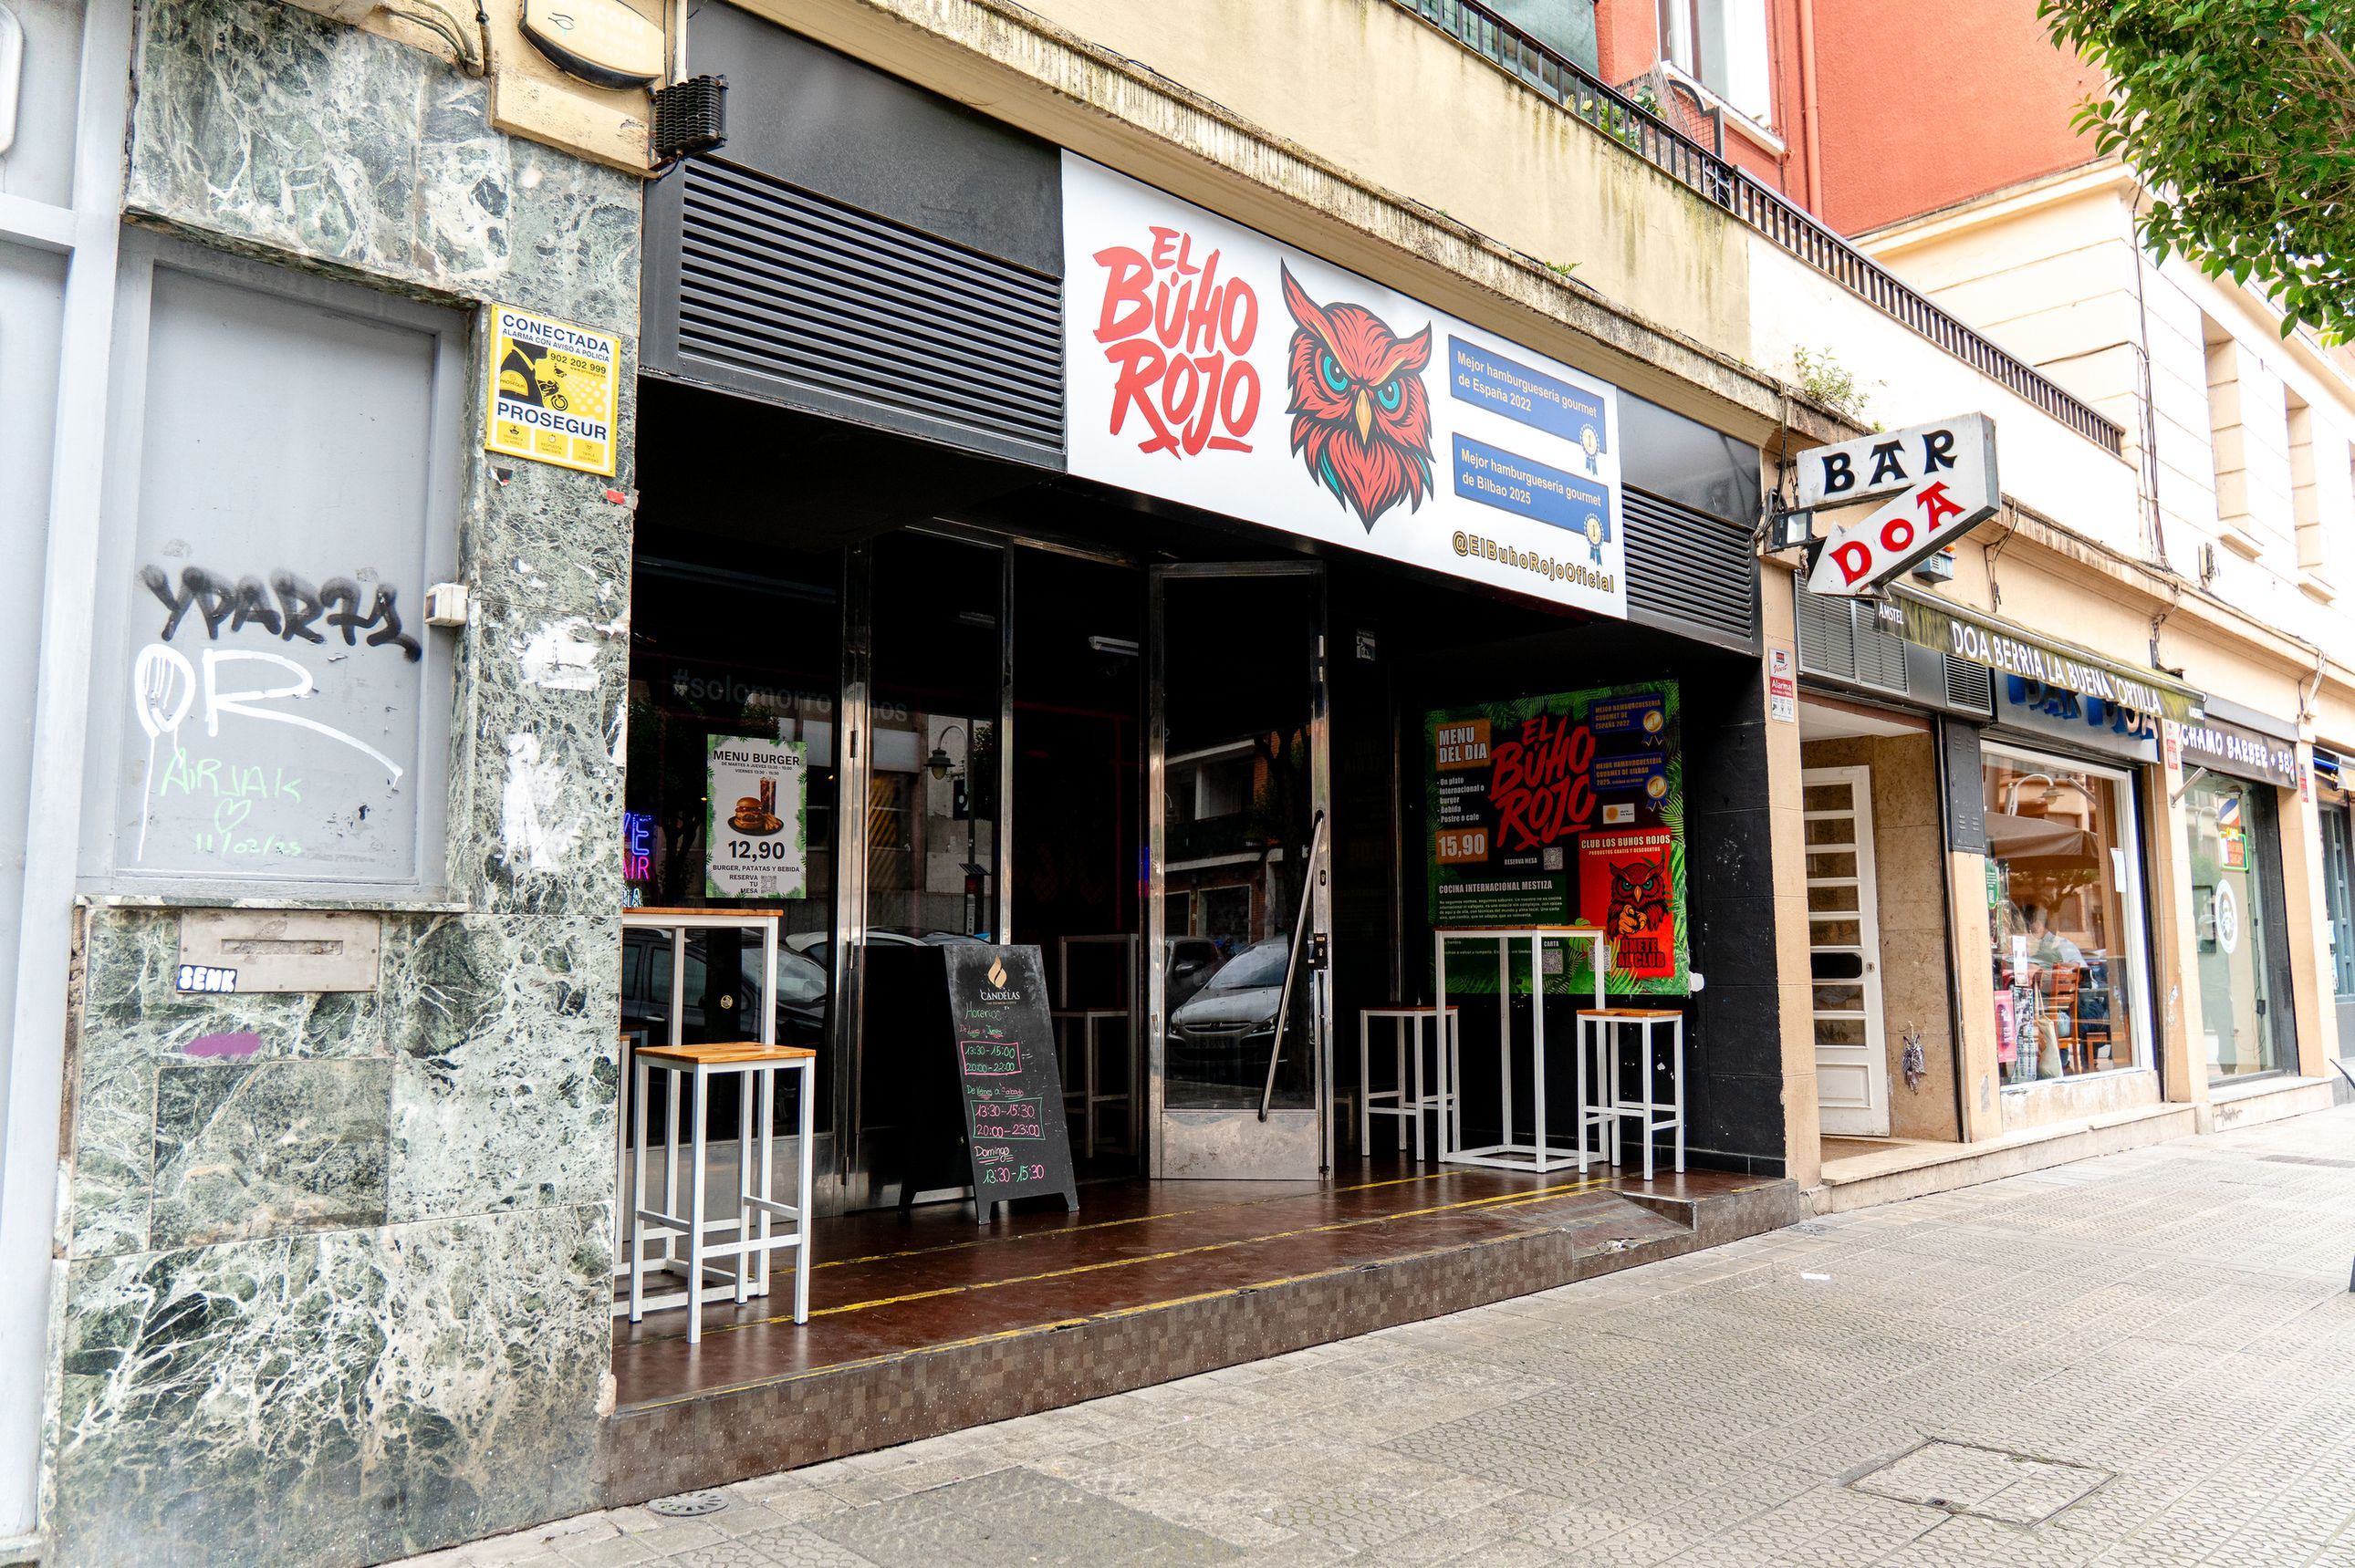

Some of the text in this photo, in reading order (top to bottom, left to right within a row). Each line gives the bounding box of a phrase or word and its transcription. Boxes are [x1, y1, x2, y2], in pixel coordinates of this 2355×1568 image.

[1149, 226, 1202, 275] EL
[503, 315, 610, 354] CONECTADA
[503, 328, 534, 342] ALARMA
[536, 337, 552, 347] CON
[553, 341, 574, 353] AVISO
[550, 352, 607, 375] 902 202 999
[1457, 350, 1598, 419] Mejor hamburguesería gourmet
[1458, 373, 1532, 411] de España 2022
[1104, 338, 1262, 461] ROJO
[497, 401, 607, 440] PROSEGUR
[1821, 429, 1958, 495] BAR
[1461, 448, 1601, 507] Mejor hamburguesería gourmet
[1462, 472, 1531, 504] de Bilbao 2025
[1829, 481, 1966, 587] DOA
[1453, 530, 1615, 593] @ElBuhoRojoOficial
[1879, 601, 1904, 625] AMSTEL
[1952, 620, 1993, 663] DOA
[1993, 635, 2046, 680] BERRIA
[2046, 653, 2068, 686] LA
[2066, 660, 2115, 699] BUENA
[1438, 726, 1474, 746] MENU
[1521, 716, 1557, 746] EL
[714, 750, 800, 766] MENU BURGER
[1439, 742, 1488, 763] DEL DIA
[2181, 724, 2224, 756] CHAMO
[2226, 735, 2267, 768] BARBER
[1440, 815, 1460, 824] Postre
[1493, 774, 1597, 853] ROJO
[728, 840, 786, 863] 12,90
[1438, 833, 1485, 857] 15,90
[1581, 835, 1671, 849] CLUB LOS BUHOS ROJOS
[713, 864, 741, 872] BURGER,
[1438, 879, 1553, 895] COCINA INTERNACIONAL MESTIZA
[1617, 951, 1666, 968] AL CLUB
[980, 988, 1020, 1001] CANDELAS
[964, 1001, 1002, 1021] Horarios
[966, 1085, 975, 1095] De
[974, 1145, 1010, 1162] Domingo
